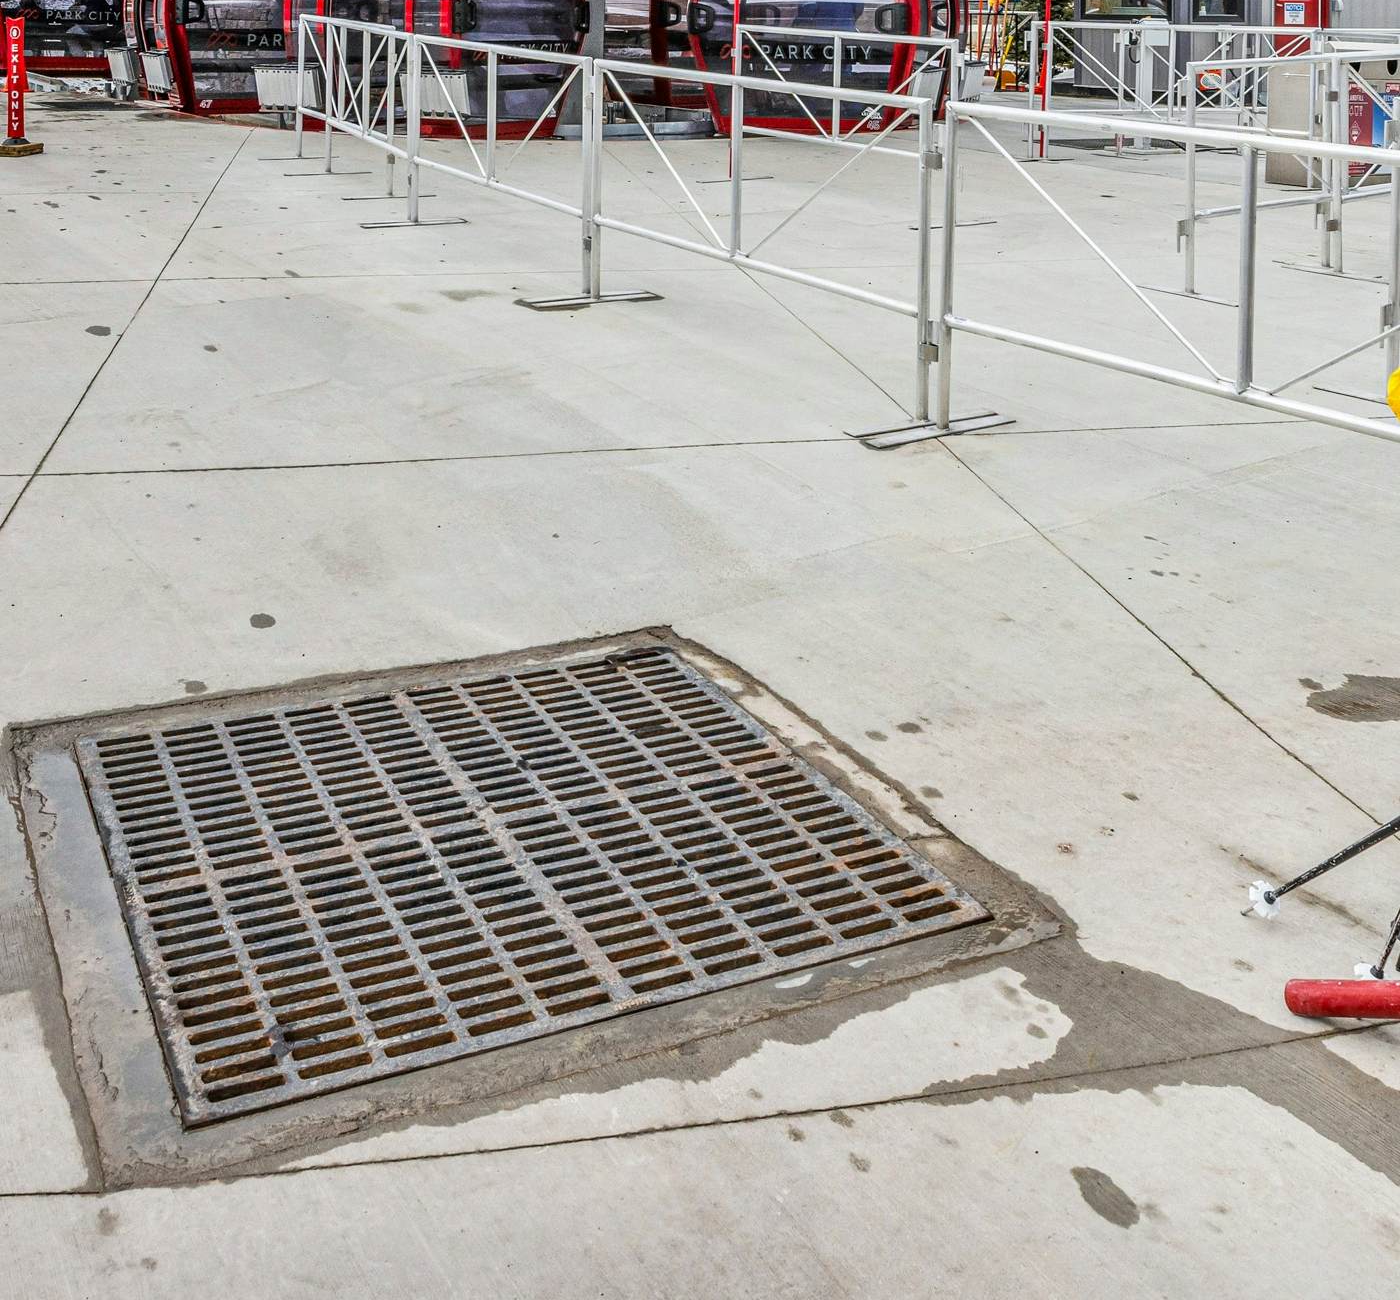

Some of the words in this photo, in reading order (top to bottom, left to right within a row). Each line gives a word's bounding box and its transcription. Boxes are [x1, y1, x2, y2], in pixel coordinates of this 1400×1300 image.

[46, 10, 83, 20] PARK
[88, 11, 121, 21] CITY
[247, 33, 283, 47] PAR
[823, 45, 872, 60] CTY
[11, 43, 20, 84] EXIT
[1350, 94, 1364, 102] ANDFILL
[11, 90, 20, 131] ONLY
